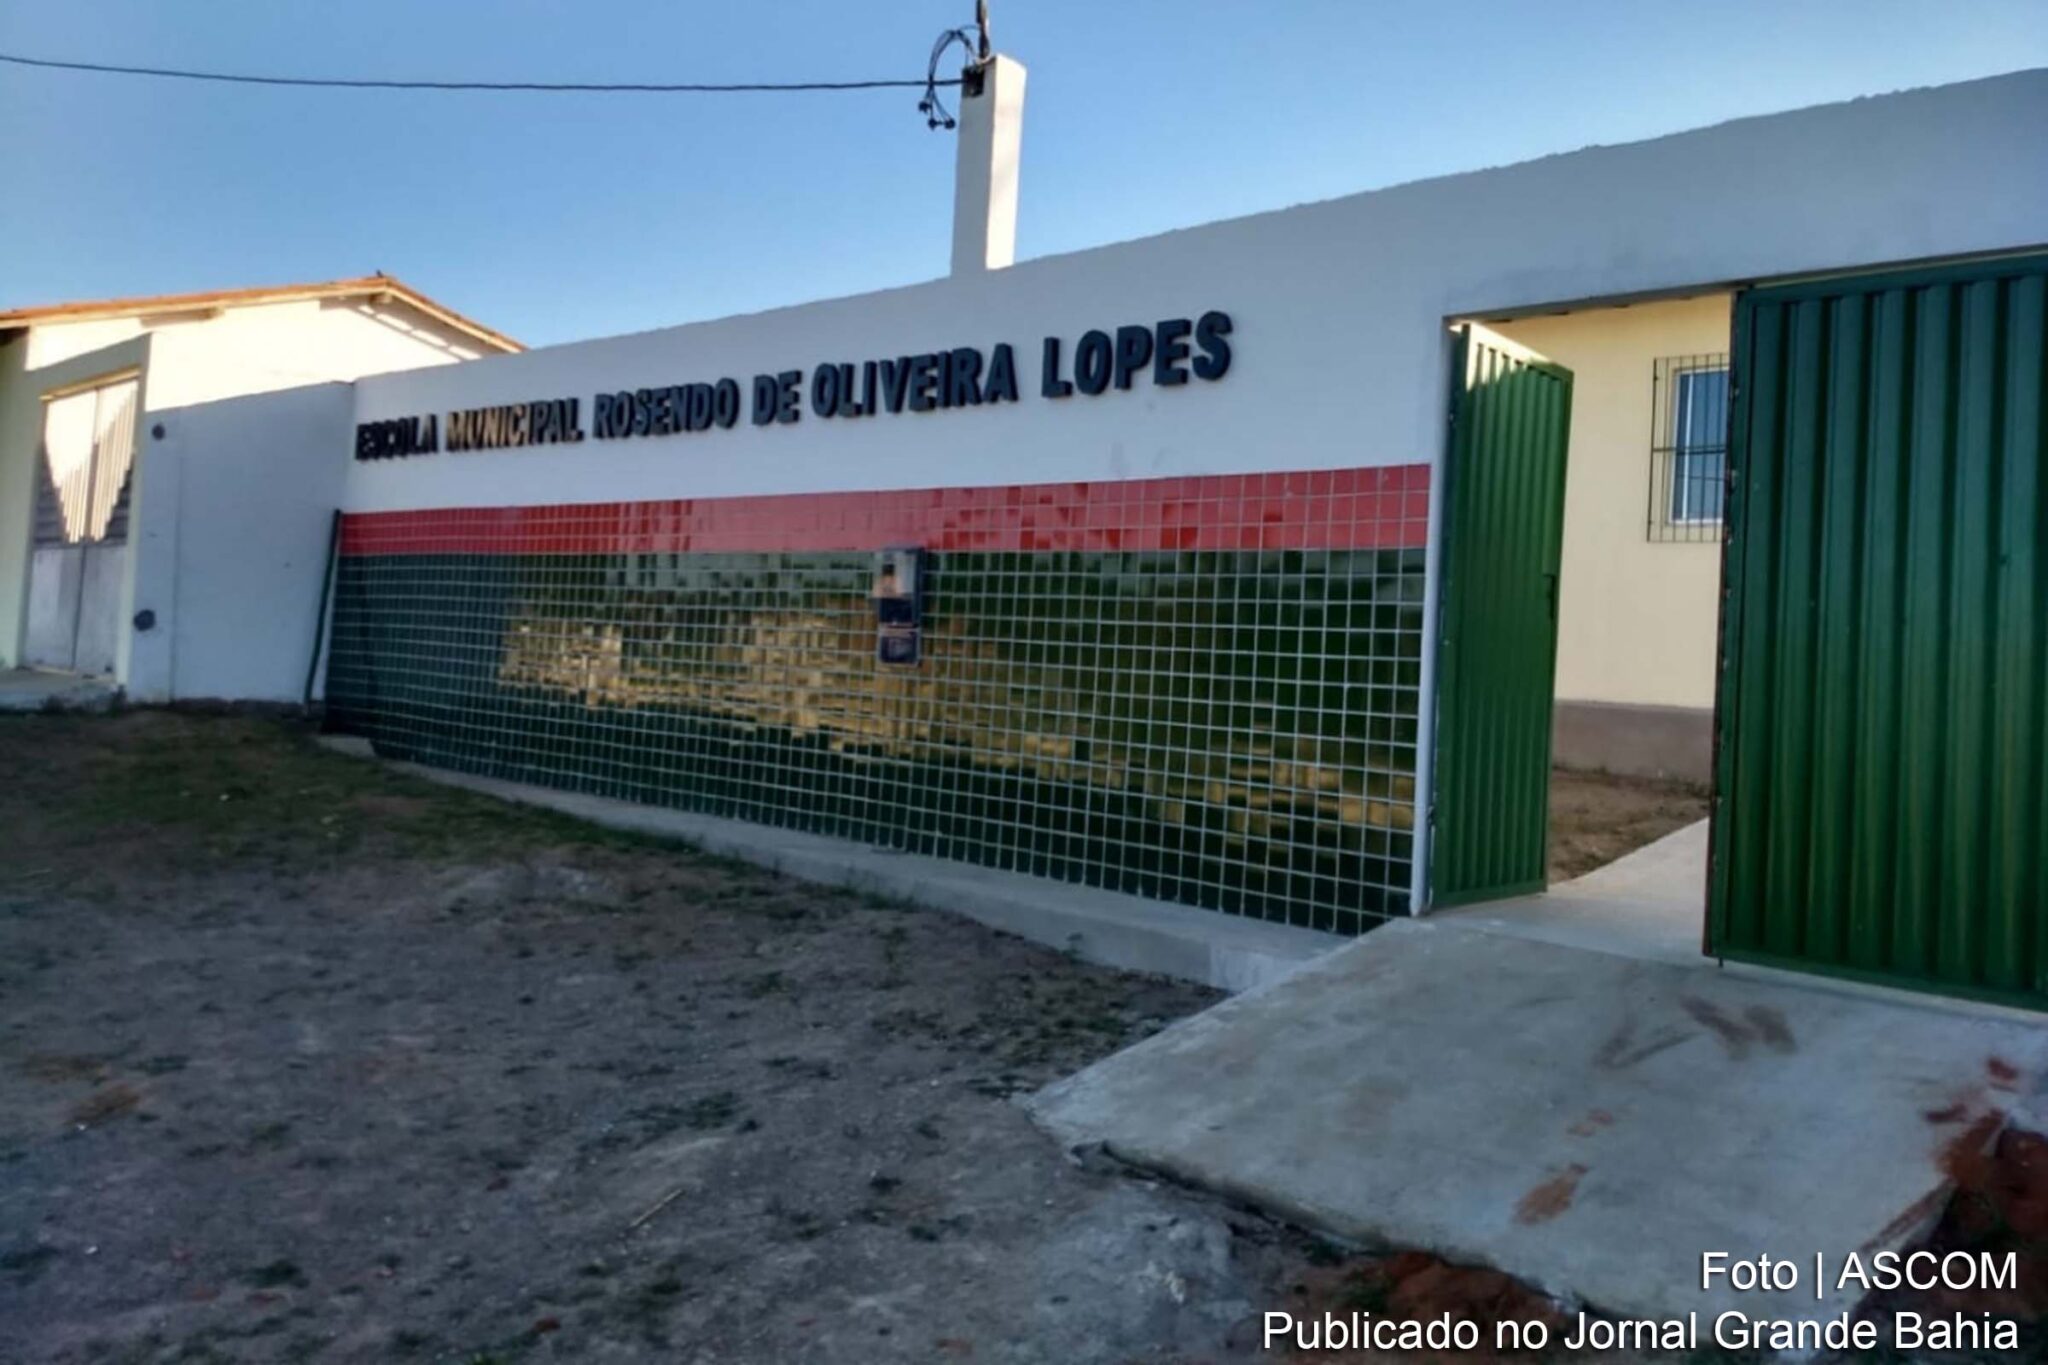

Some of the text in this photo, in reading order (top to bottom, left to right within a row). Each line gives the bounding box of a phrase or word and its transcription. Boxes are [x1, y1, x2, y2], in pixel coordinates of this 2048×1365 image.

[355, 311, 1233, 460] ESCOLA MUNICIPAL ROSENDO DE OLIVEIRA LOPES
